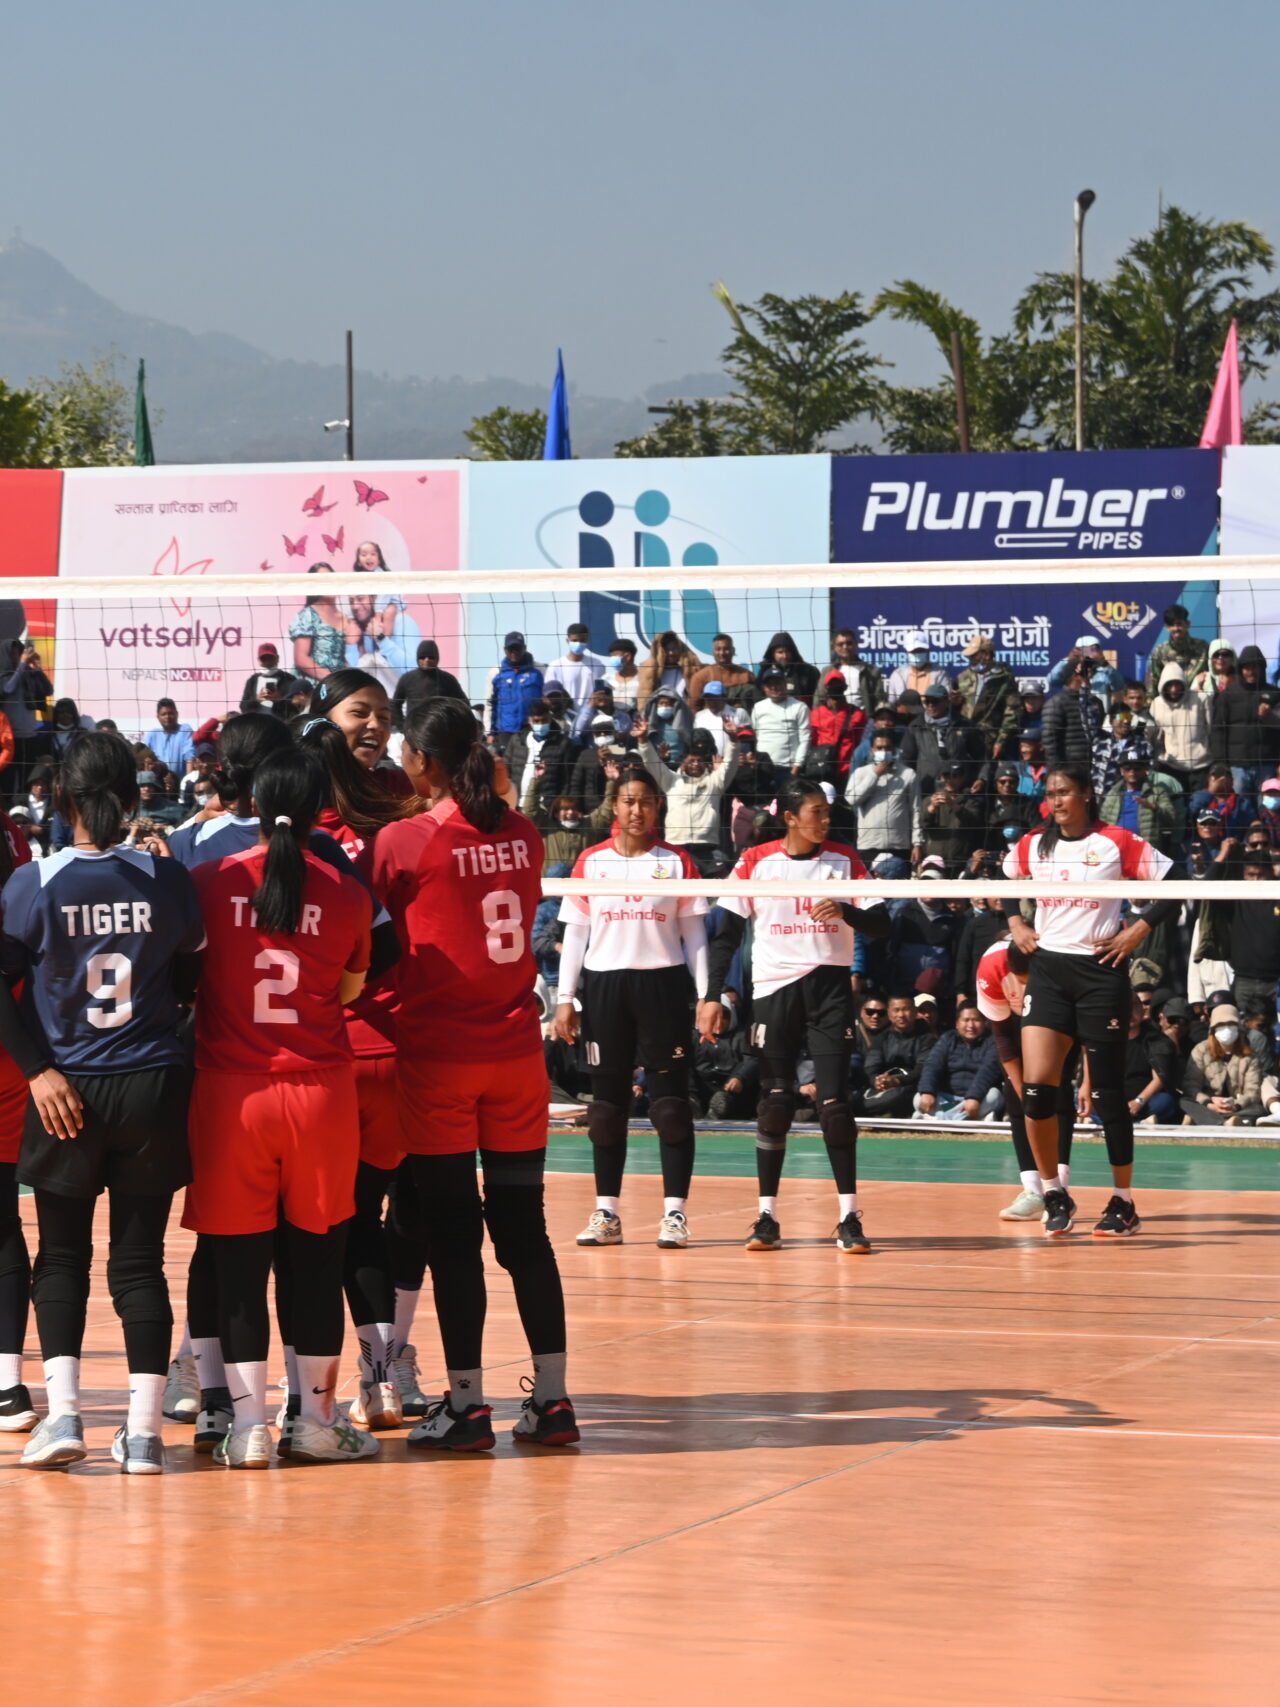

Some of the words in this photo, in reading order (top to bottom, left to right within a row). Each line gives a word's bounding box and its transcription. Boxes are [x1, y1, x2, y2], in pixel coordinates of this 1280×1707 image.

[1078, 532, 1143, 550] PIPES
[99, 619, 242, 655] vatsalya
[993, 650, 1050, 667] ITTINGS
[451, 839, 531, 877] TIGER
[61, 901, 153, 937] TIGER
[481, 889, 525, 965] 8
[86, 952, 133, 1029] 9
[254, 948, 300, 1024] 2
[585, 1040, 601, 1067] 10
